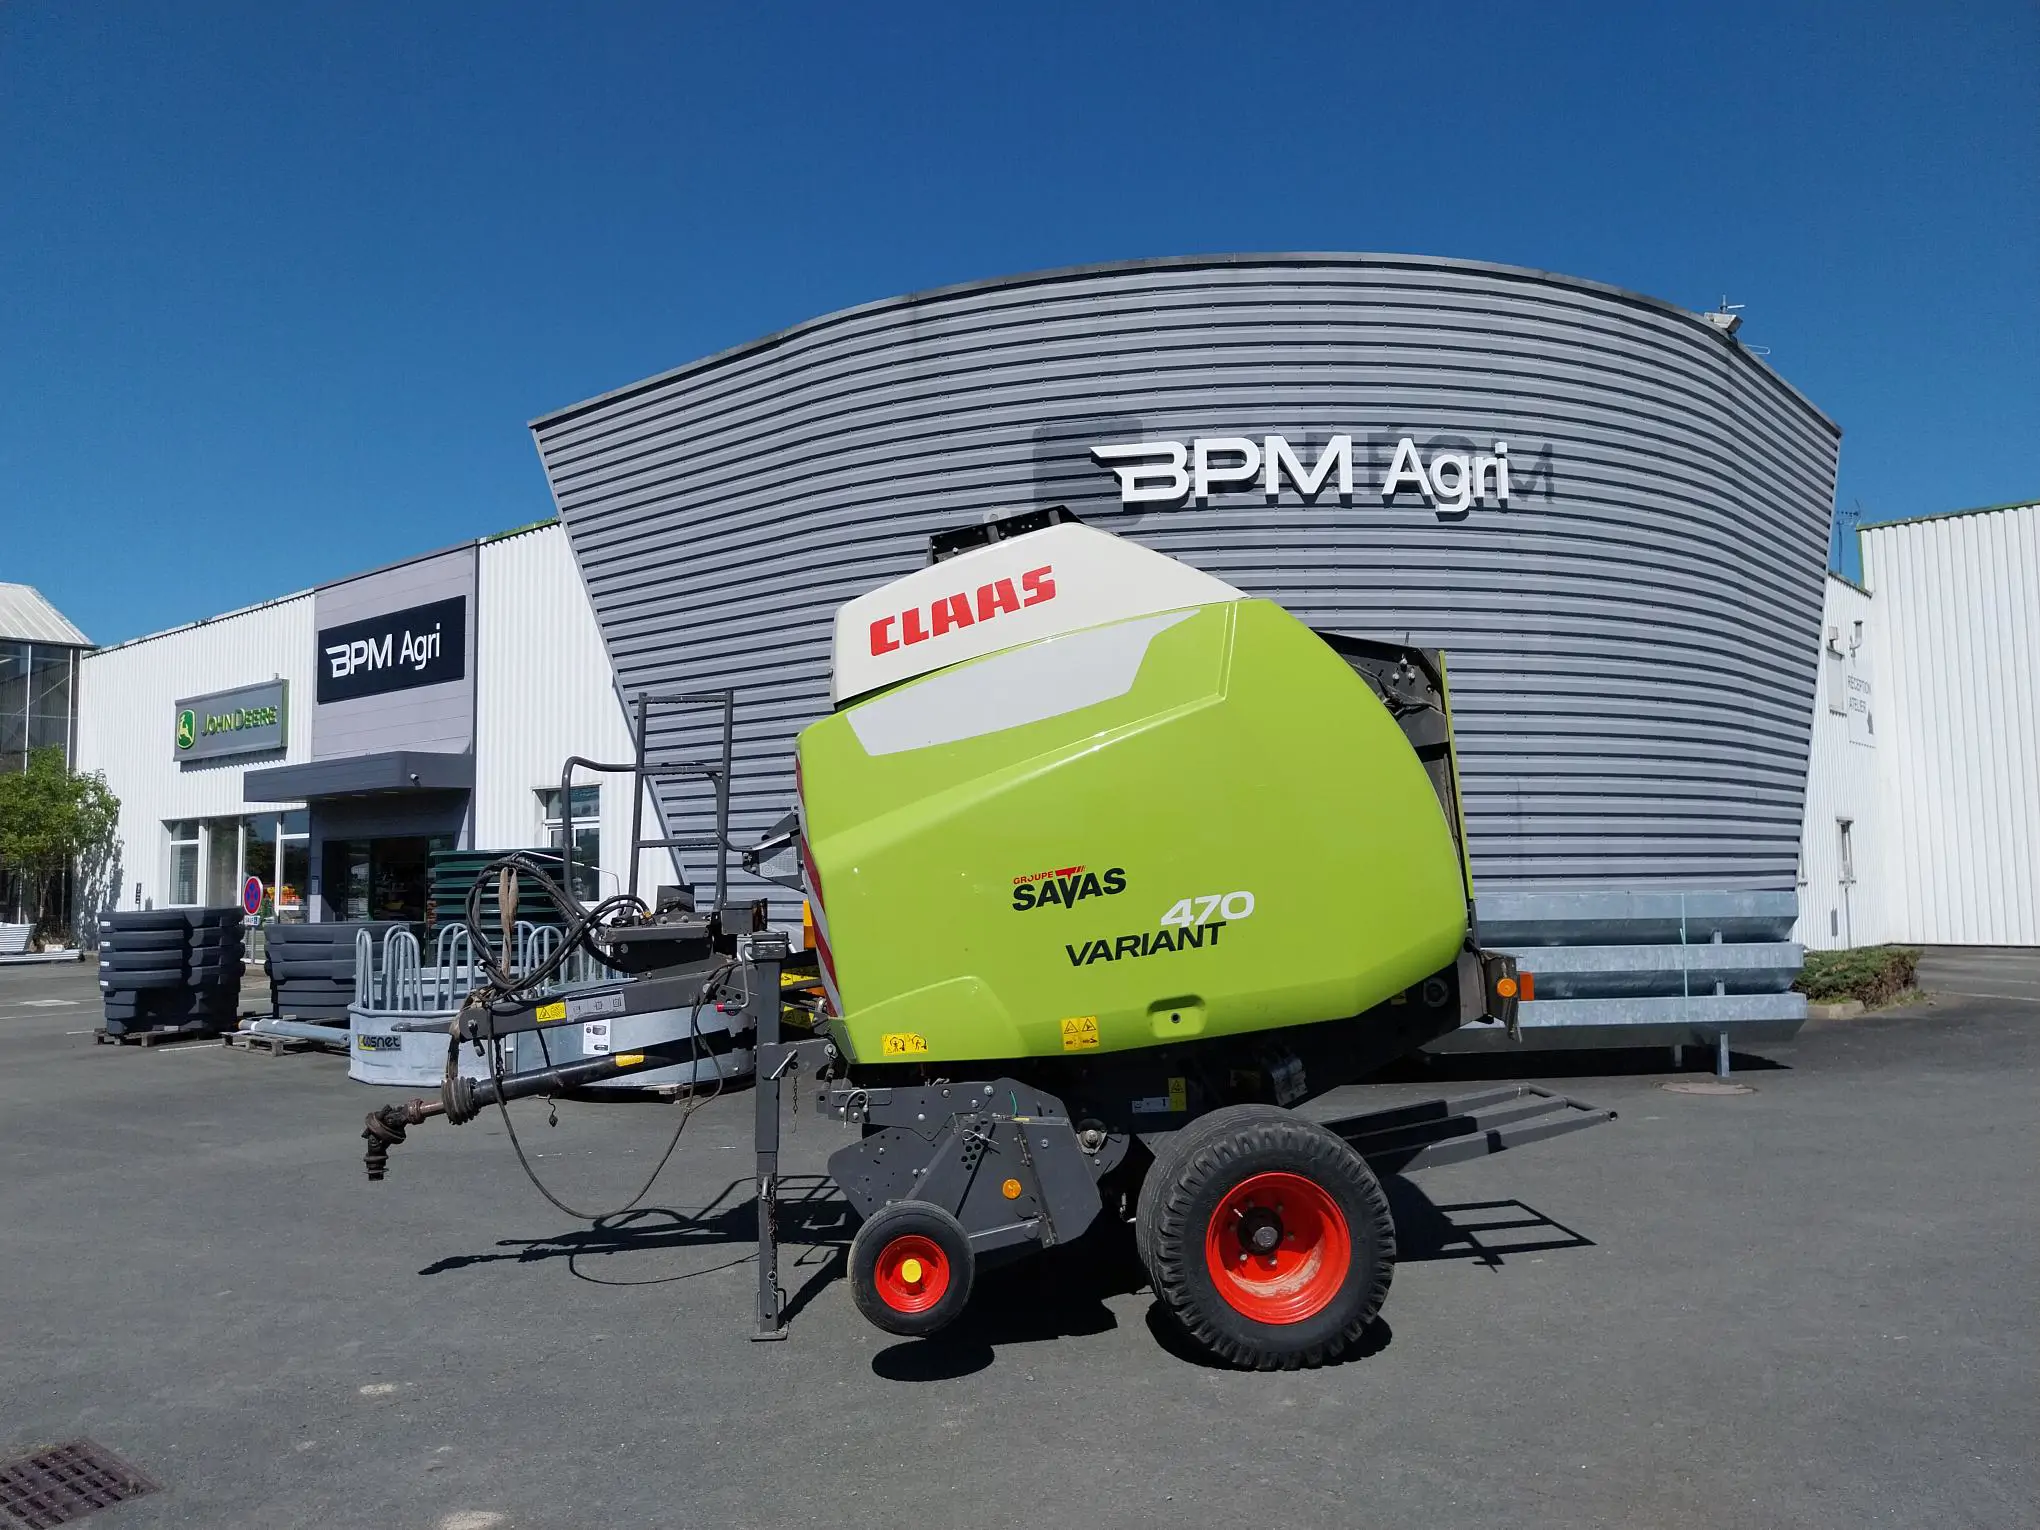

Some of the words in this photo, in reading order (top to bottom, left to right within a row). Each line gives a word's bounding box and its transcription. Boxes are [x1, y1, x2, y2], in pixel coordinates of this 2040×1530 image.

[1090, 435, 1353, 502] BPM
[1382, 437, 1509, 513] Agri
[870, 565, 1056, 656] CLAAS
[326, 633, 393, 678] BPM
[399, 622, 440, 671] Agri
[201, 712, 234, 736] JOHN
[235, 705, 278, 731] DEERE
[1012, 867, 1127, 911] SAVAS
[1013, 871, 1054, 885] GROUPE
[1160, 890, 1255, 928] 470
[1065, 920, 1227, 967] VARIANT
